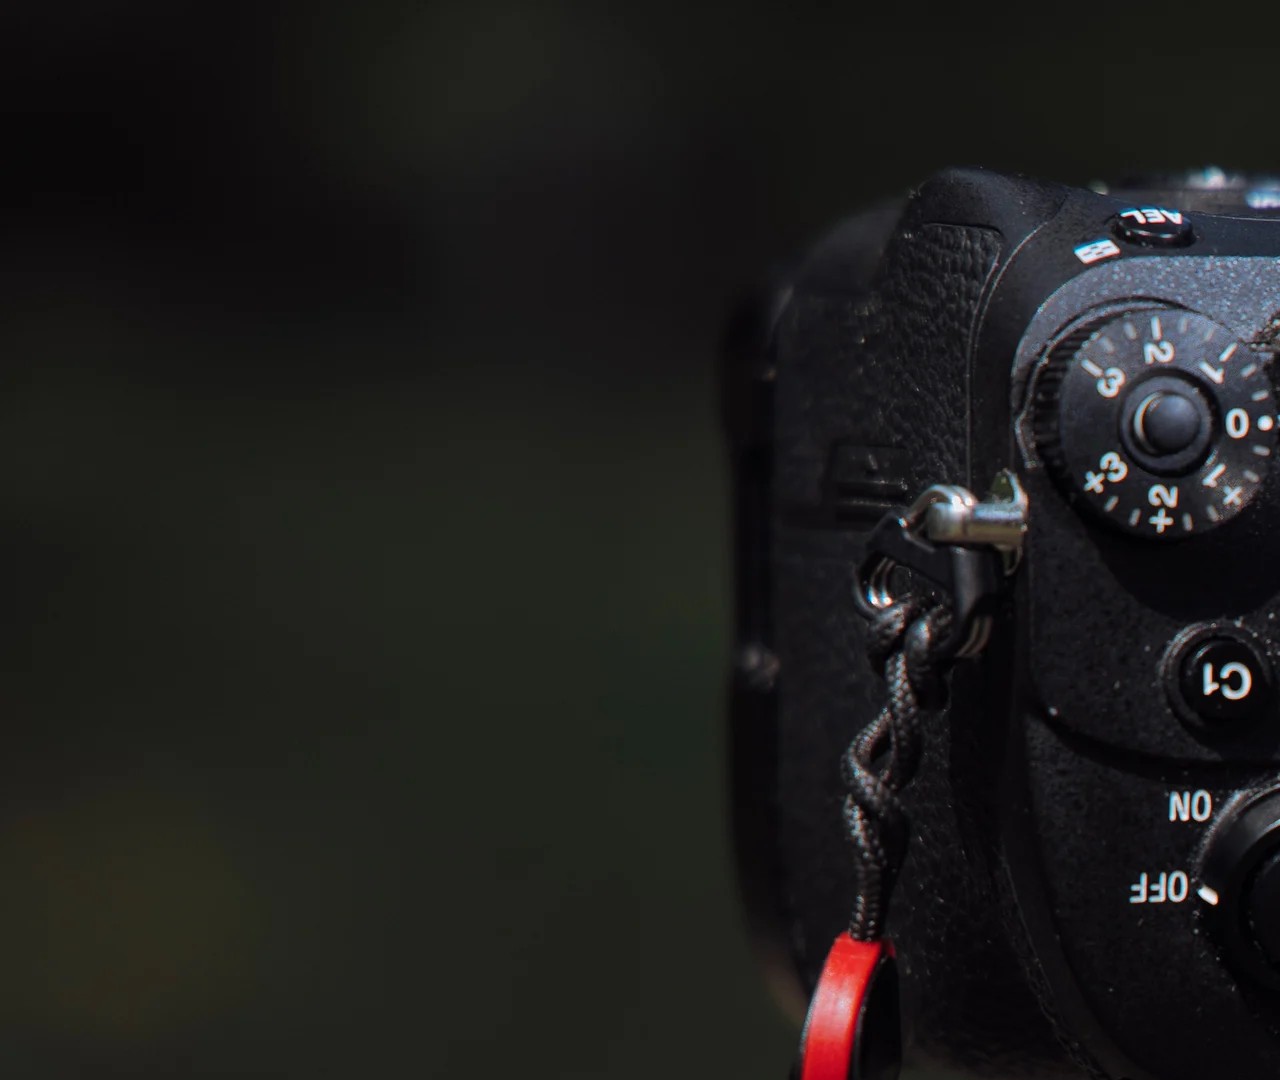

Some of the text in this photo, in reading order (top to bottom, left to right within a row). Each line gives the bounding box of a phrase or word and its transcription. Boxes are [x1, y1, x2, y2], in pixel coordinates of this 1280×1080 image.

[1120, 207, 1183, 226] AEL
[1224, 407, 1250, 439] 0
[1202, 661, 1252, 700] C1
[1168, 790, 1212, 822] ON
[1129, 871, 1188, 903] OFF
